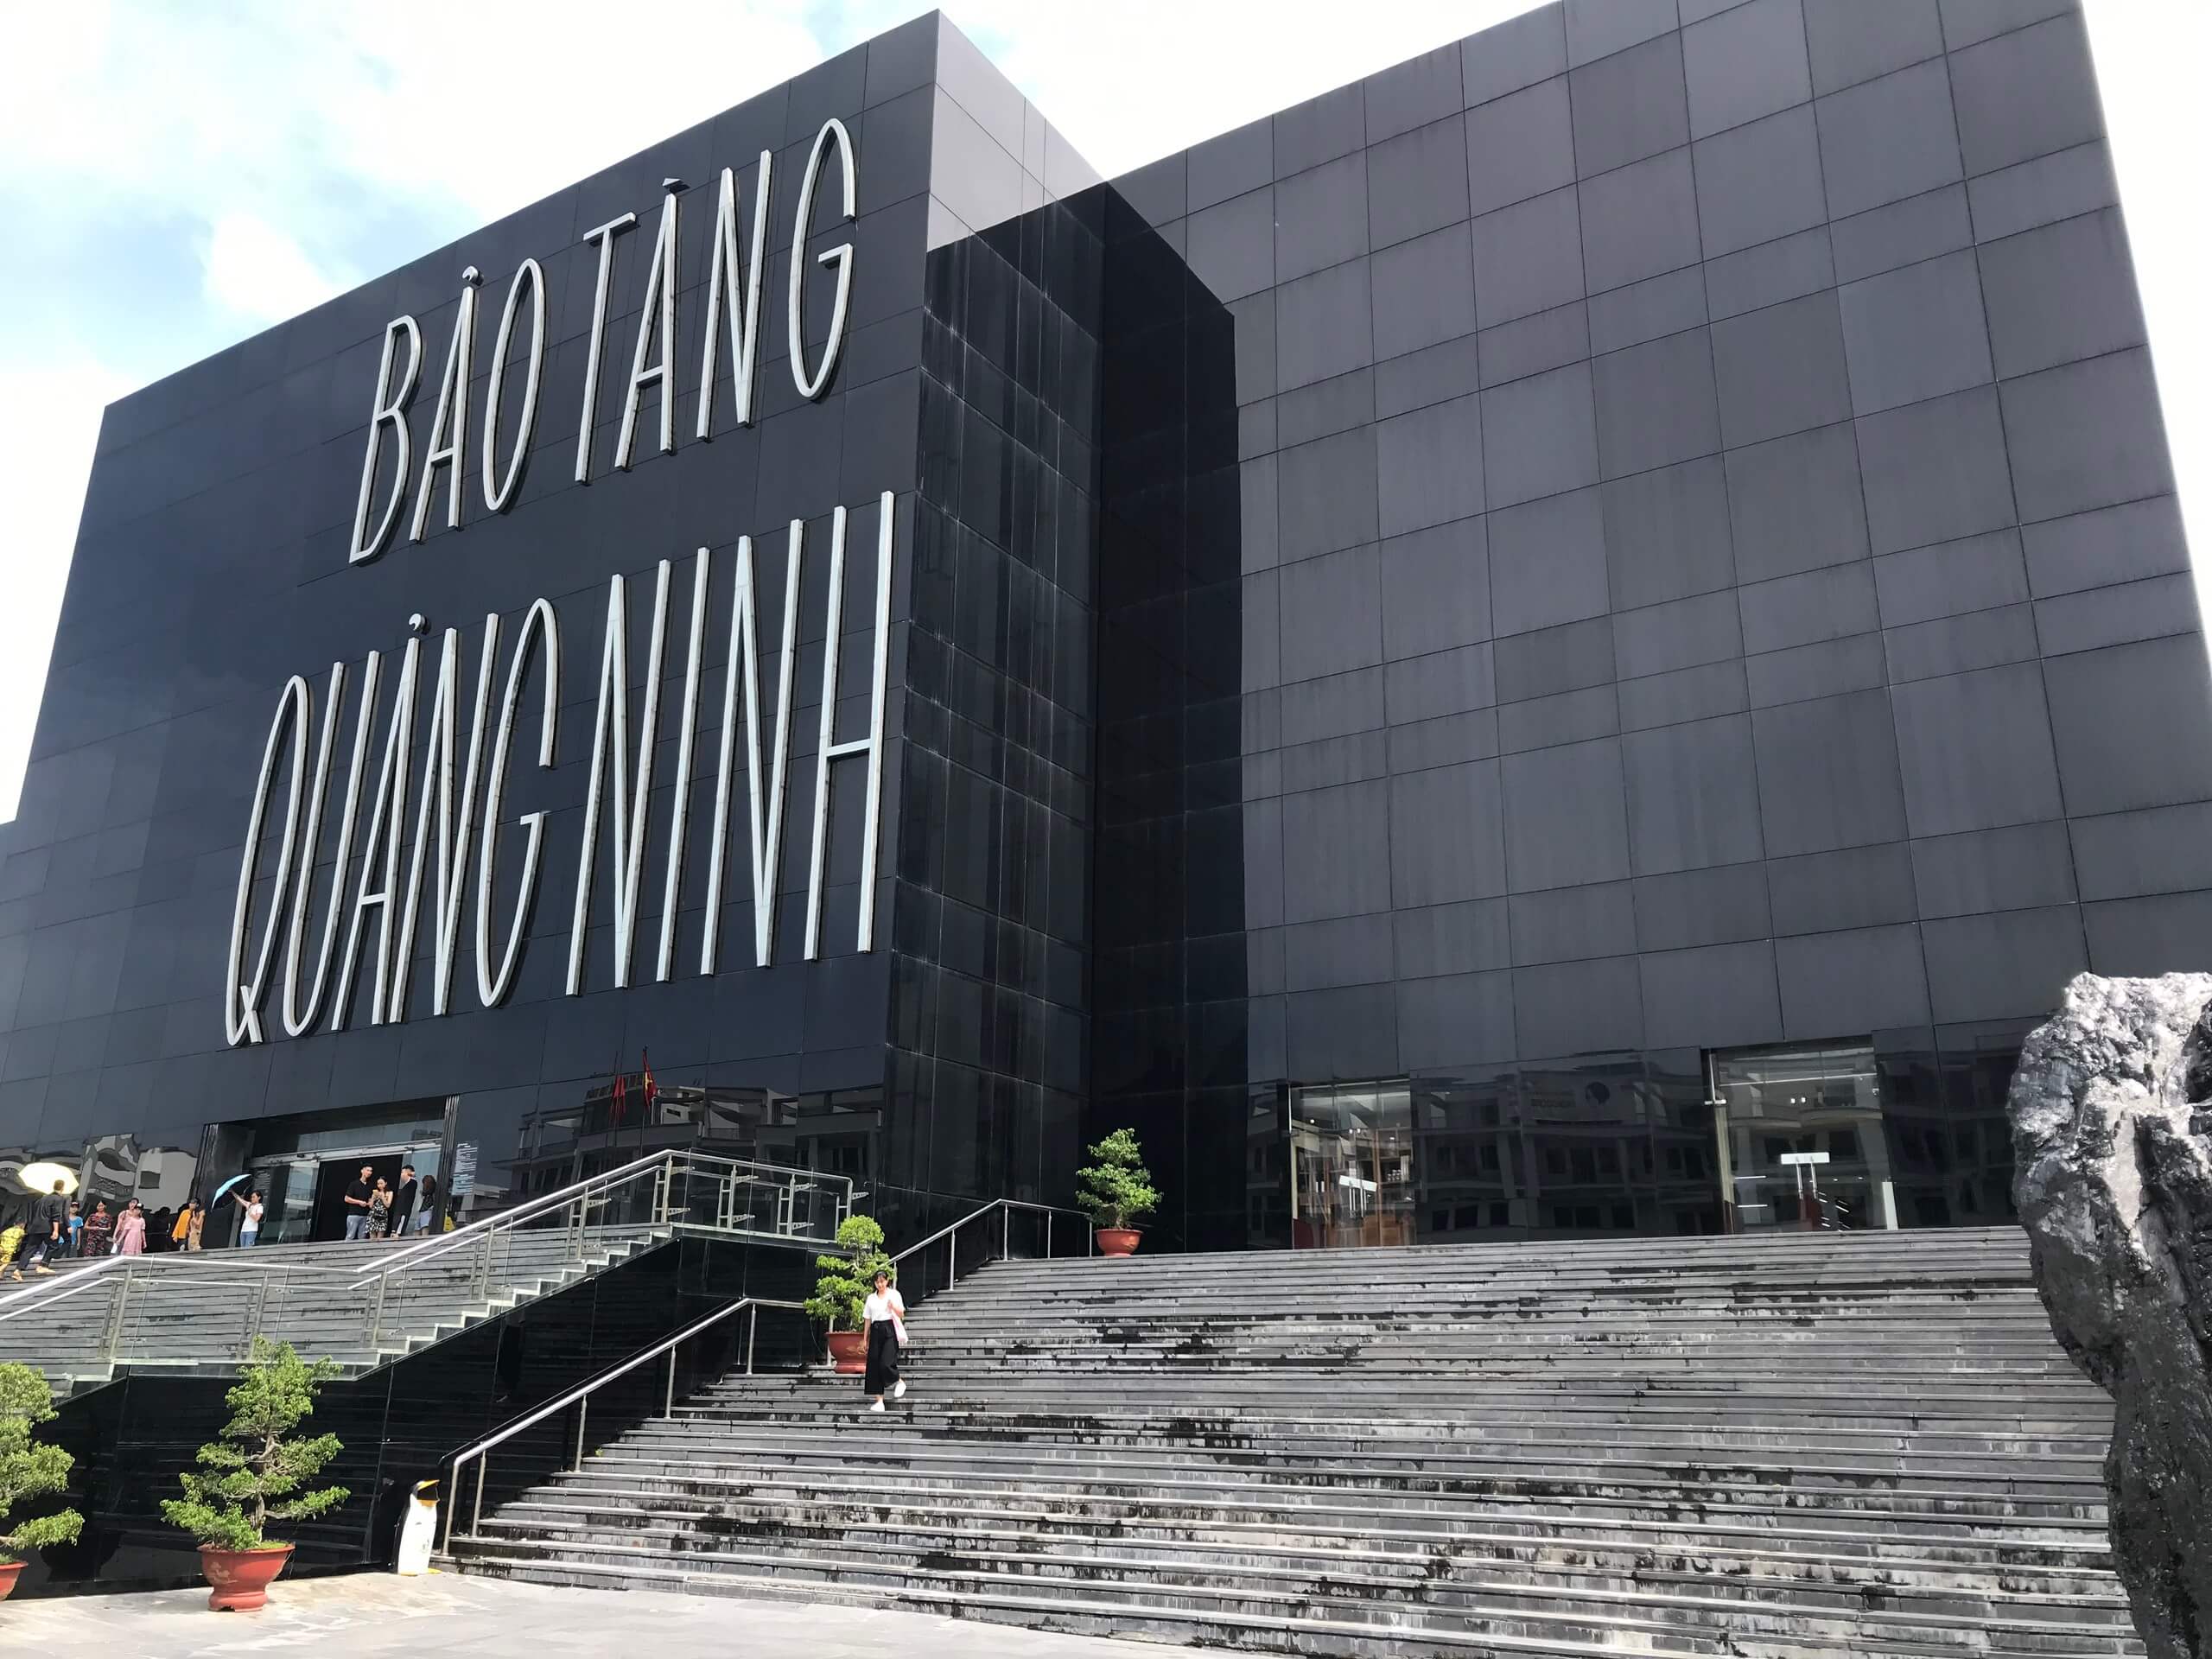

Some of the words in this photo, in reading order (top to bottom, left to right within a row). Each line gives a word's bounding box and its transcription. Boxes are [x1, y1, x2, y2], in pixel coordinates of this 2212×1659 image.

[348, 257, 548, 564] BẢO
[575, 118, 858, 484] TÀNG
[226, 597, 560, 1046] QUẢNG
[565, 491, 895, 997] NINH
